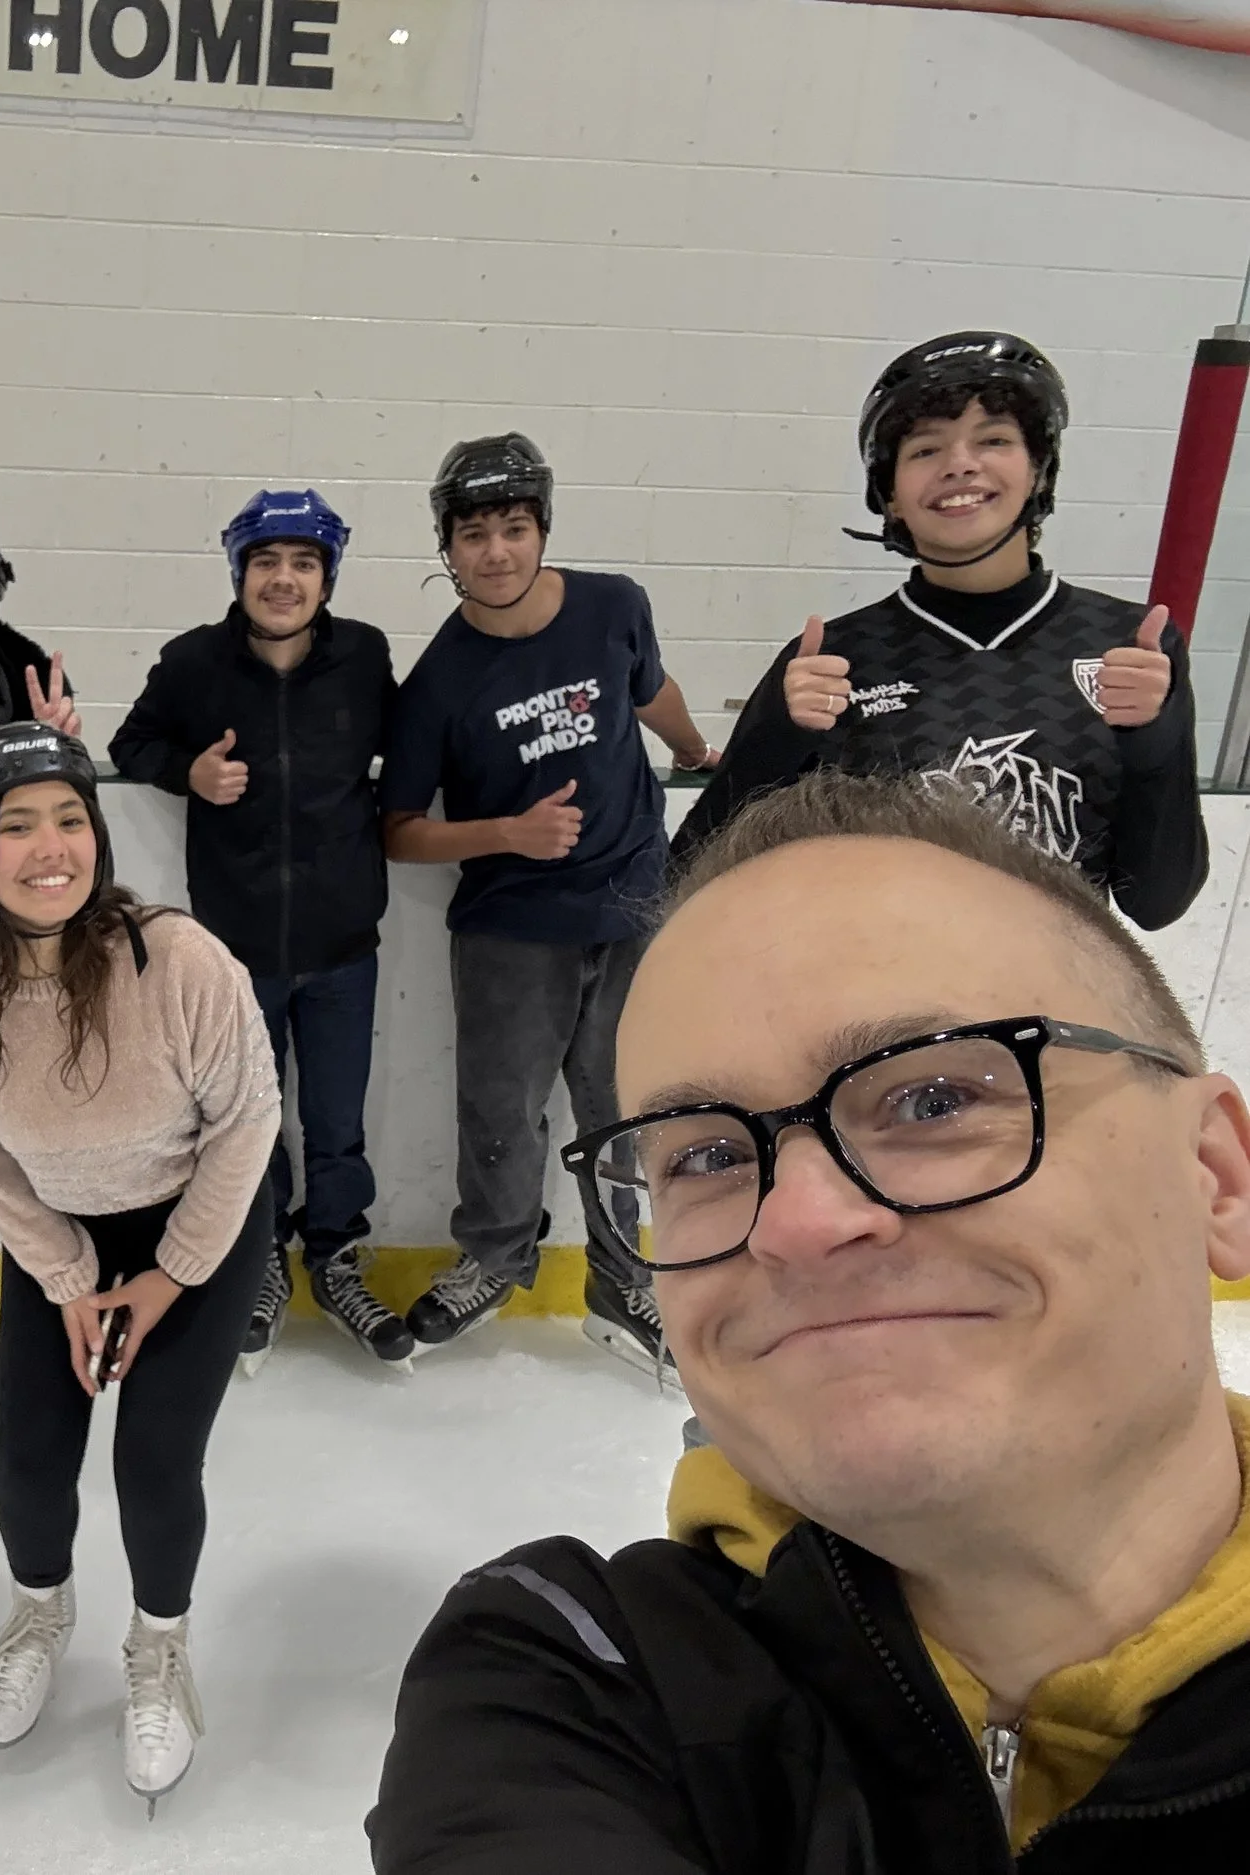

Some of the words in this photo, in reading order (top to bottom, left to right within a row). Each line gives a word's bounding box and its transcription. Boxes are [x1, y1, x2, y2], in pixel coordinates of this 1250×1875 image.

[8, 0, 340, 90] HOME
[923, 344, 986, 362] CCM
[540, 708, 596, 735] PRO
[2, 737, 58, 754] BAUER
